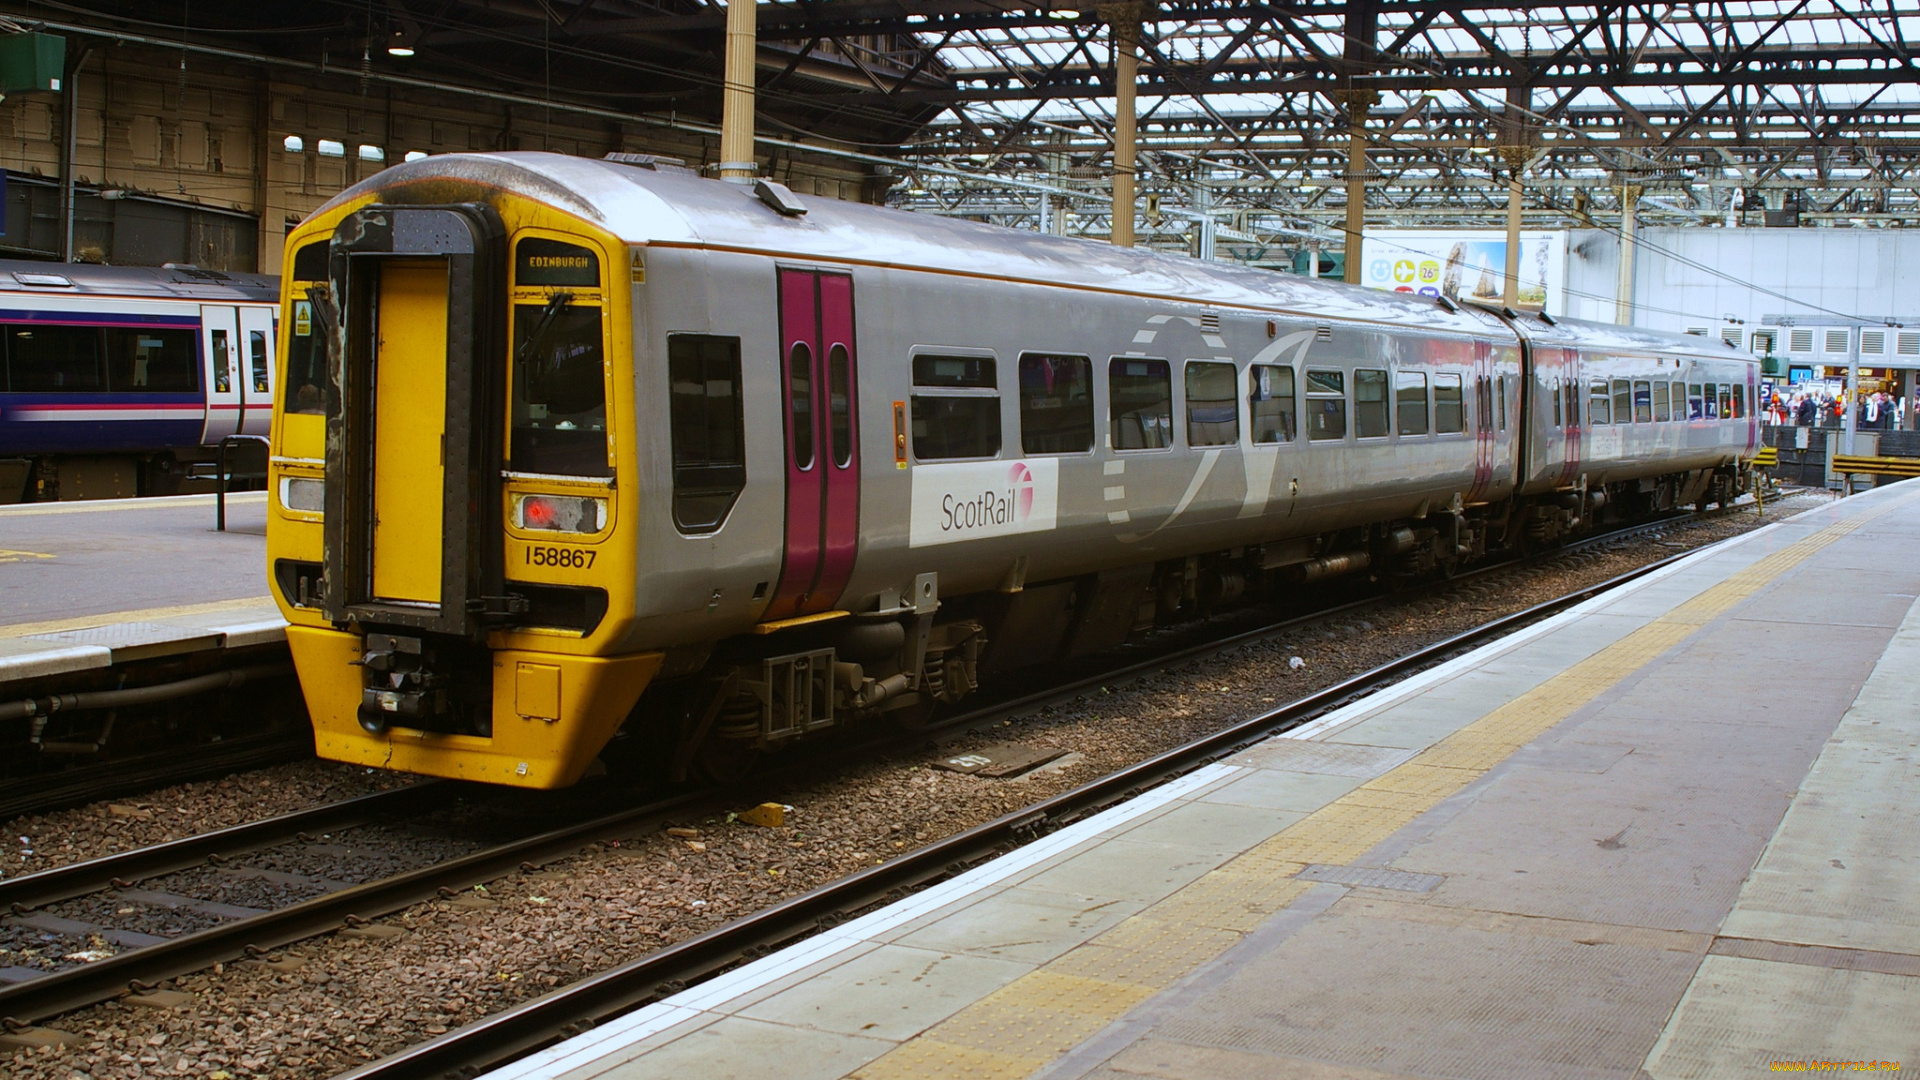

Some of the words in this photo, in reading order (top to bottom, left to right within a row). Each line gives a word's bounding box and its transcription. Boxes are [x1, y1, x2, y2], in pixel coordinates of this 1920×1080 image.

[529, 256, 588, 268] EDINBURGH
[940, 488, 1016, 531] ScotRail
[525, 545, 597, 570] 158867
